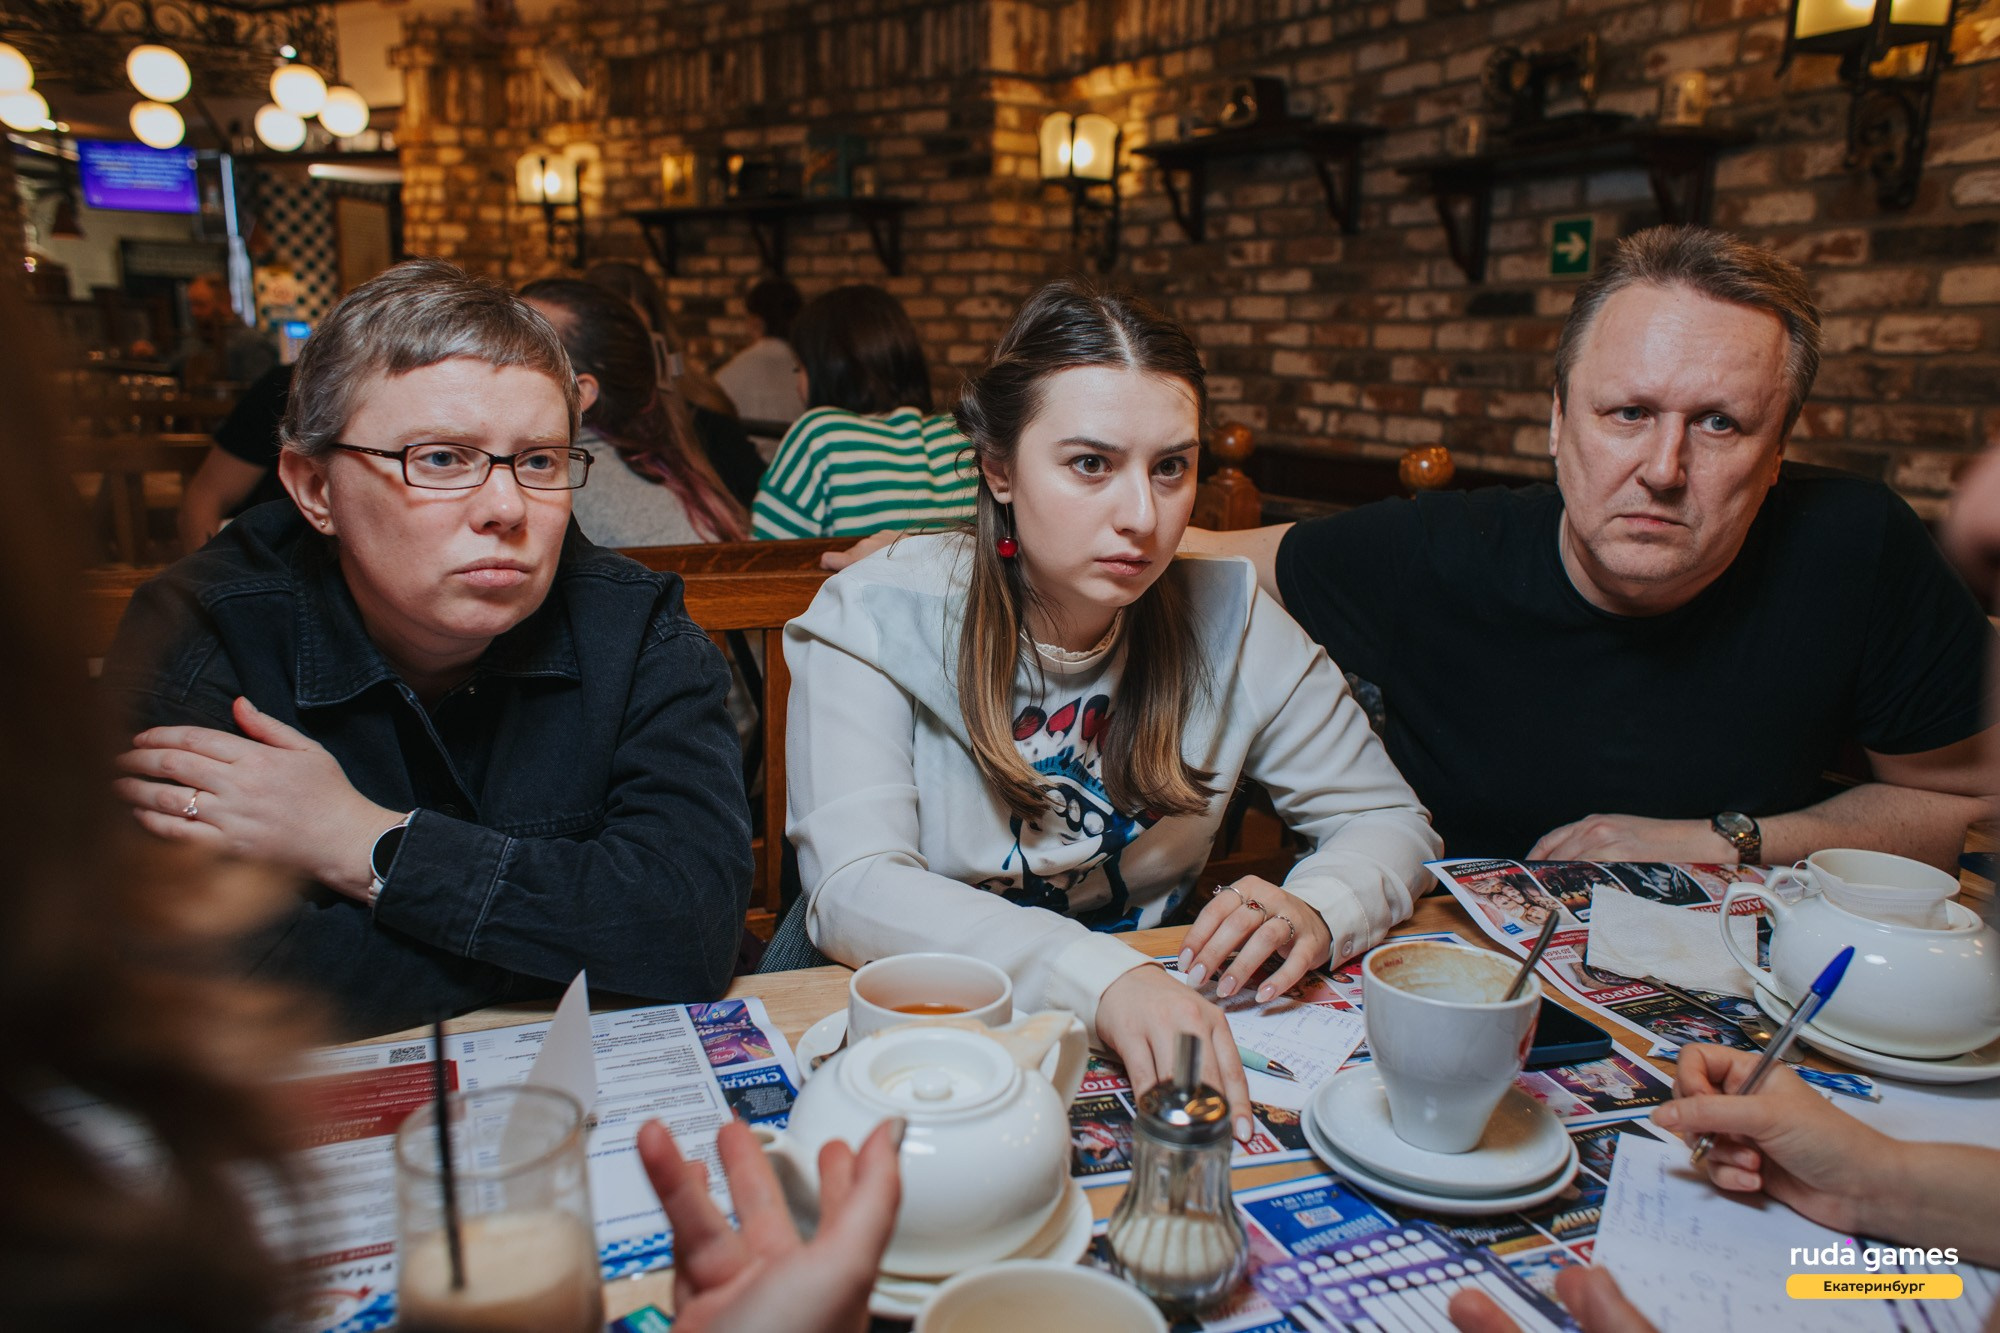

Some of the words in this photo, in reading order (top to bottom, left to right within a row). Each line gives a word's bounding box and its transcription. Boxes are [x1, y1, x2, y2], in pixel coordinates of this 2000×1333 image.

[1471, 871, 1499, 880] АПРЕЛЯ
[1588, 984, 1654, 1003] ОДАРОК
[719, 1072, 781, 1089] СКИД
[1079, 1079, 1115, 1091] ПО
[1612, 1097, 1649, 1106] МАРТА
